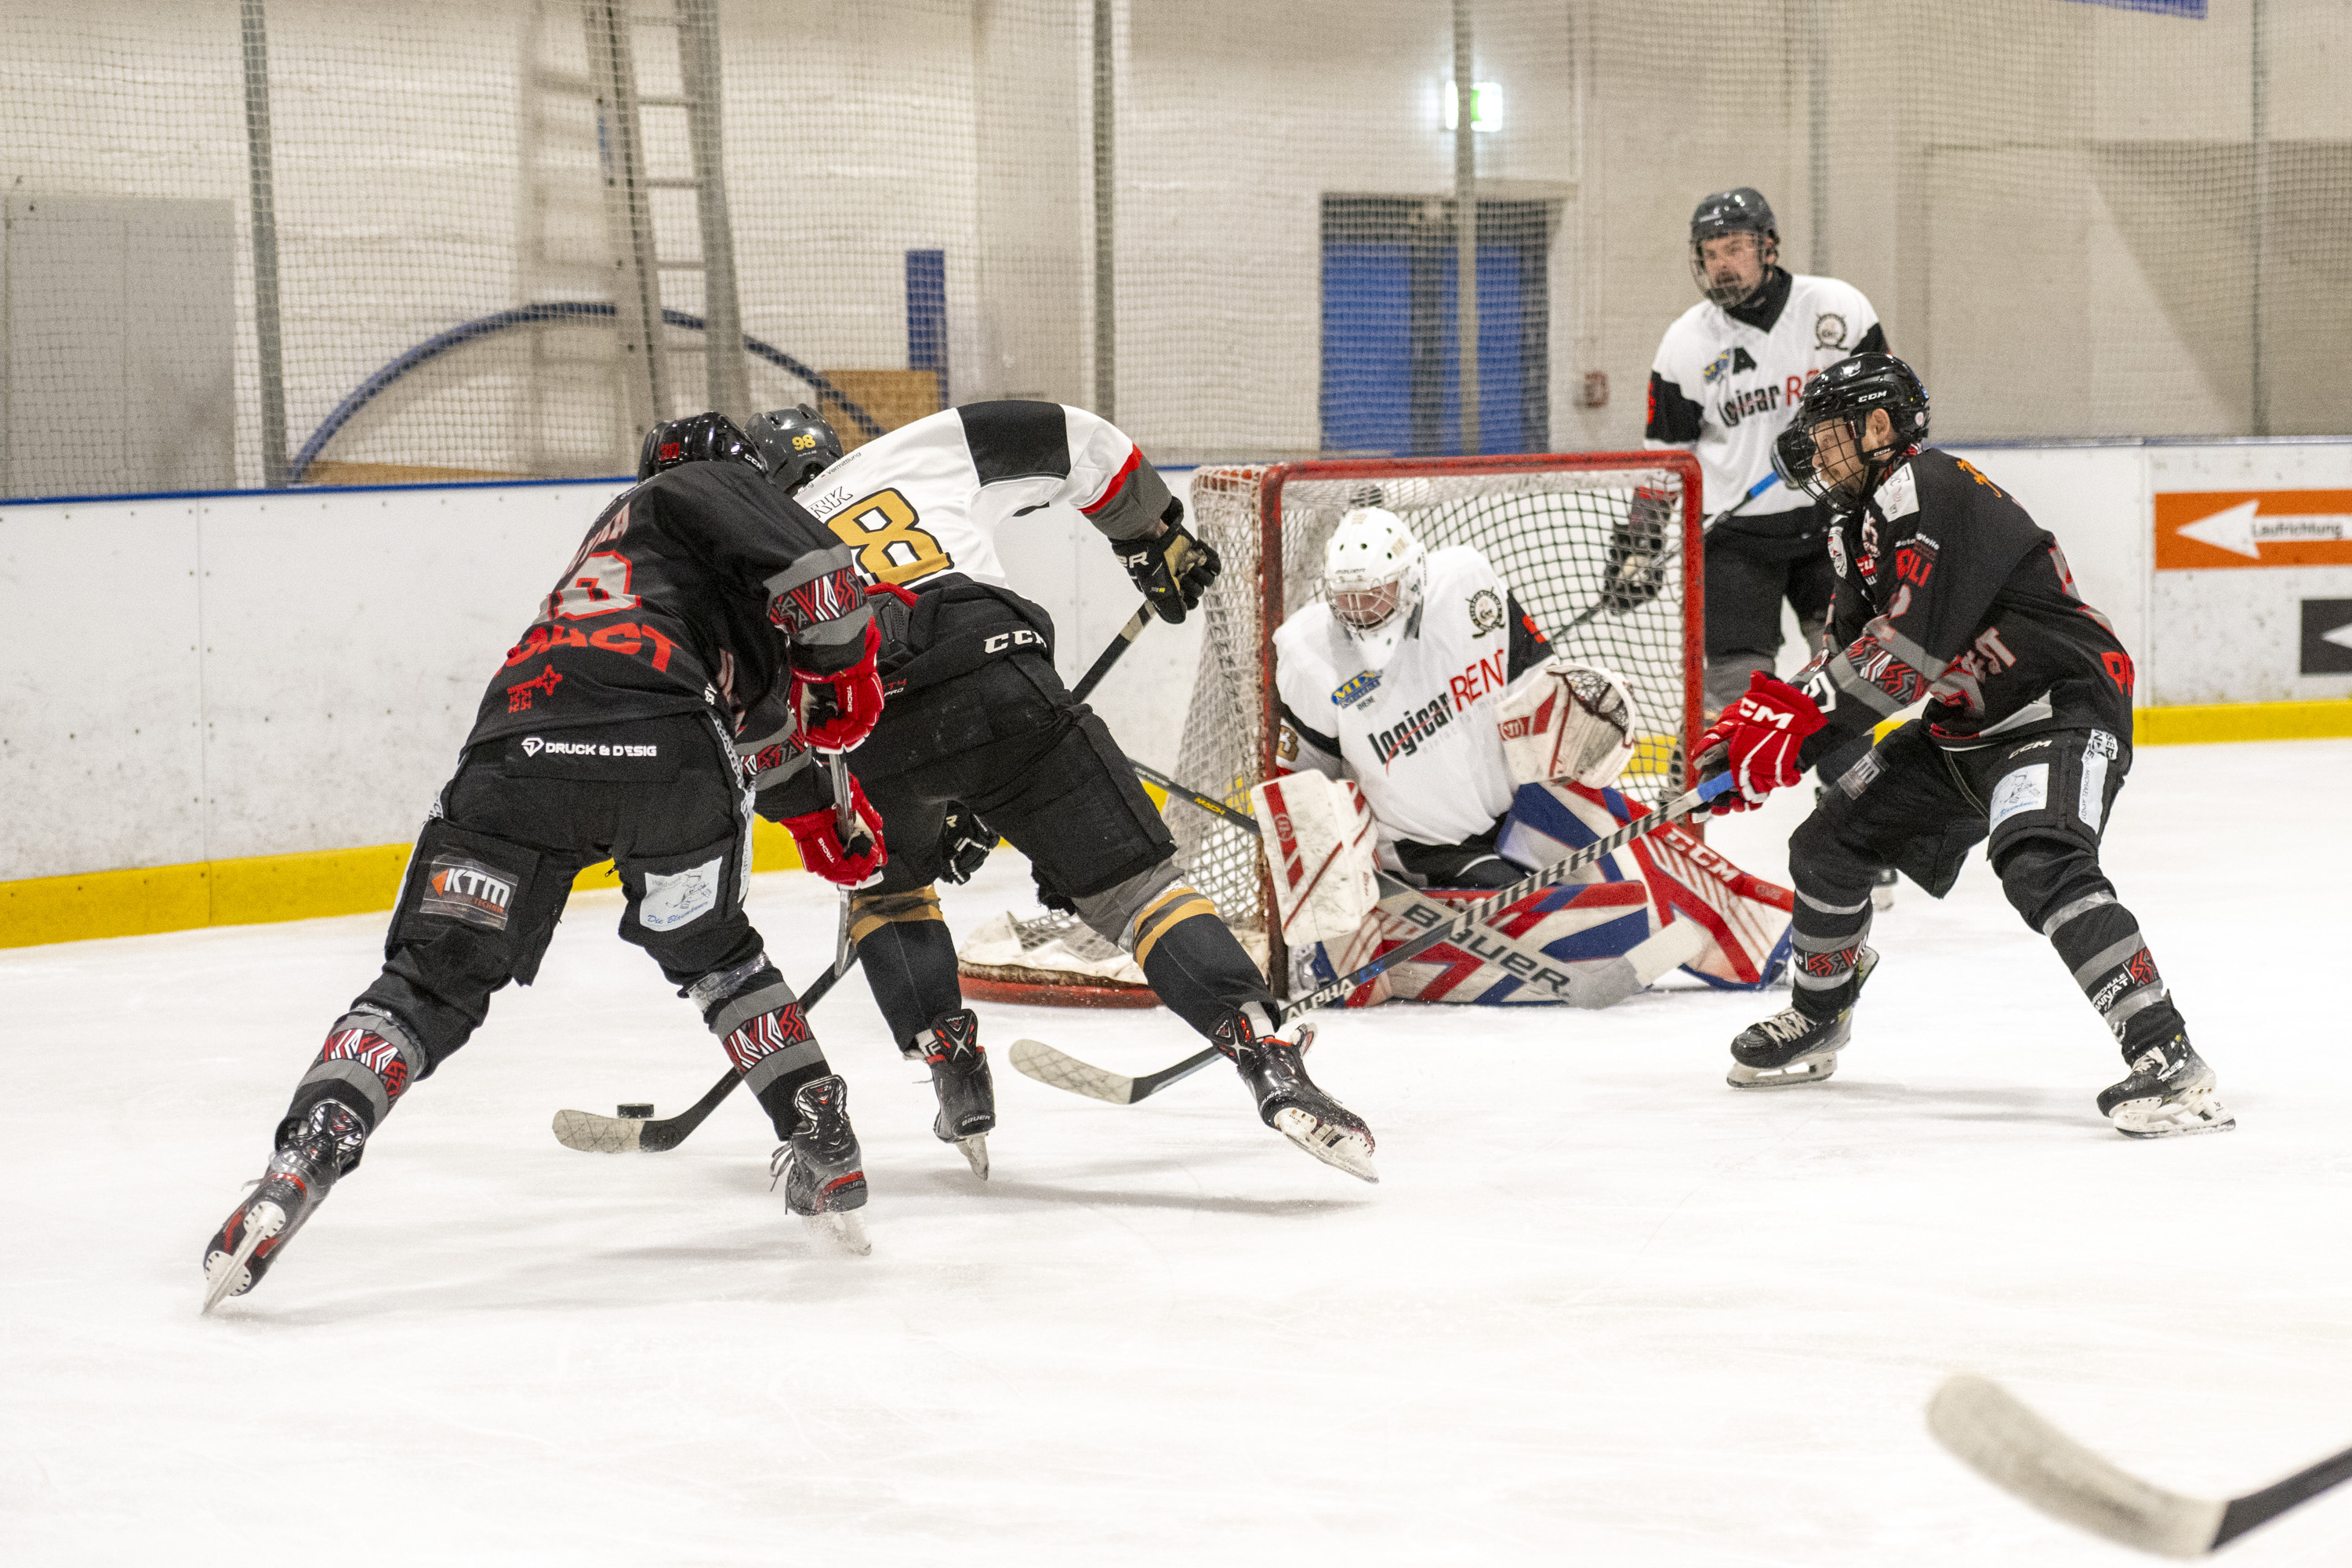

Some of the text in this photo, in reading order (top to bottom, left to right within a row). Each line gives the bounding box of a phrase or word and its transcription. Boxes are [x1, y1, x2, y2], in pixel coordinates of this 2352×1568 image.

[1733, 347, 1757, 375] A
[1857, 390, 1887, 403] CCM
[792, 434, 816, 451] 98
[1873, 448, 1891, 457] CCM
[826, 452, 862, 475] Vermittlung
[2252, 523, 2342, 540] Laufrichtung
[1367, 691, 1454, 766] logicar
[1449, 648, 1504, 713] REN
[545, 742, 597, 756] DRUCK
[598, 745, 610, 757] &
[2008, 739, 2053, 760] CCM
[1194, 797, 1226, 816] MACH
[818, 837, 836, 863] TACKS
[1663, 827, 1741, 884] CCM
[444, 867, 510, 909] KTM
[647, 914, 663, 924] Die
[1285, 978, 1357, 1023] ALPHA
[961, 1114, 991, 1127] BAUER
